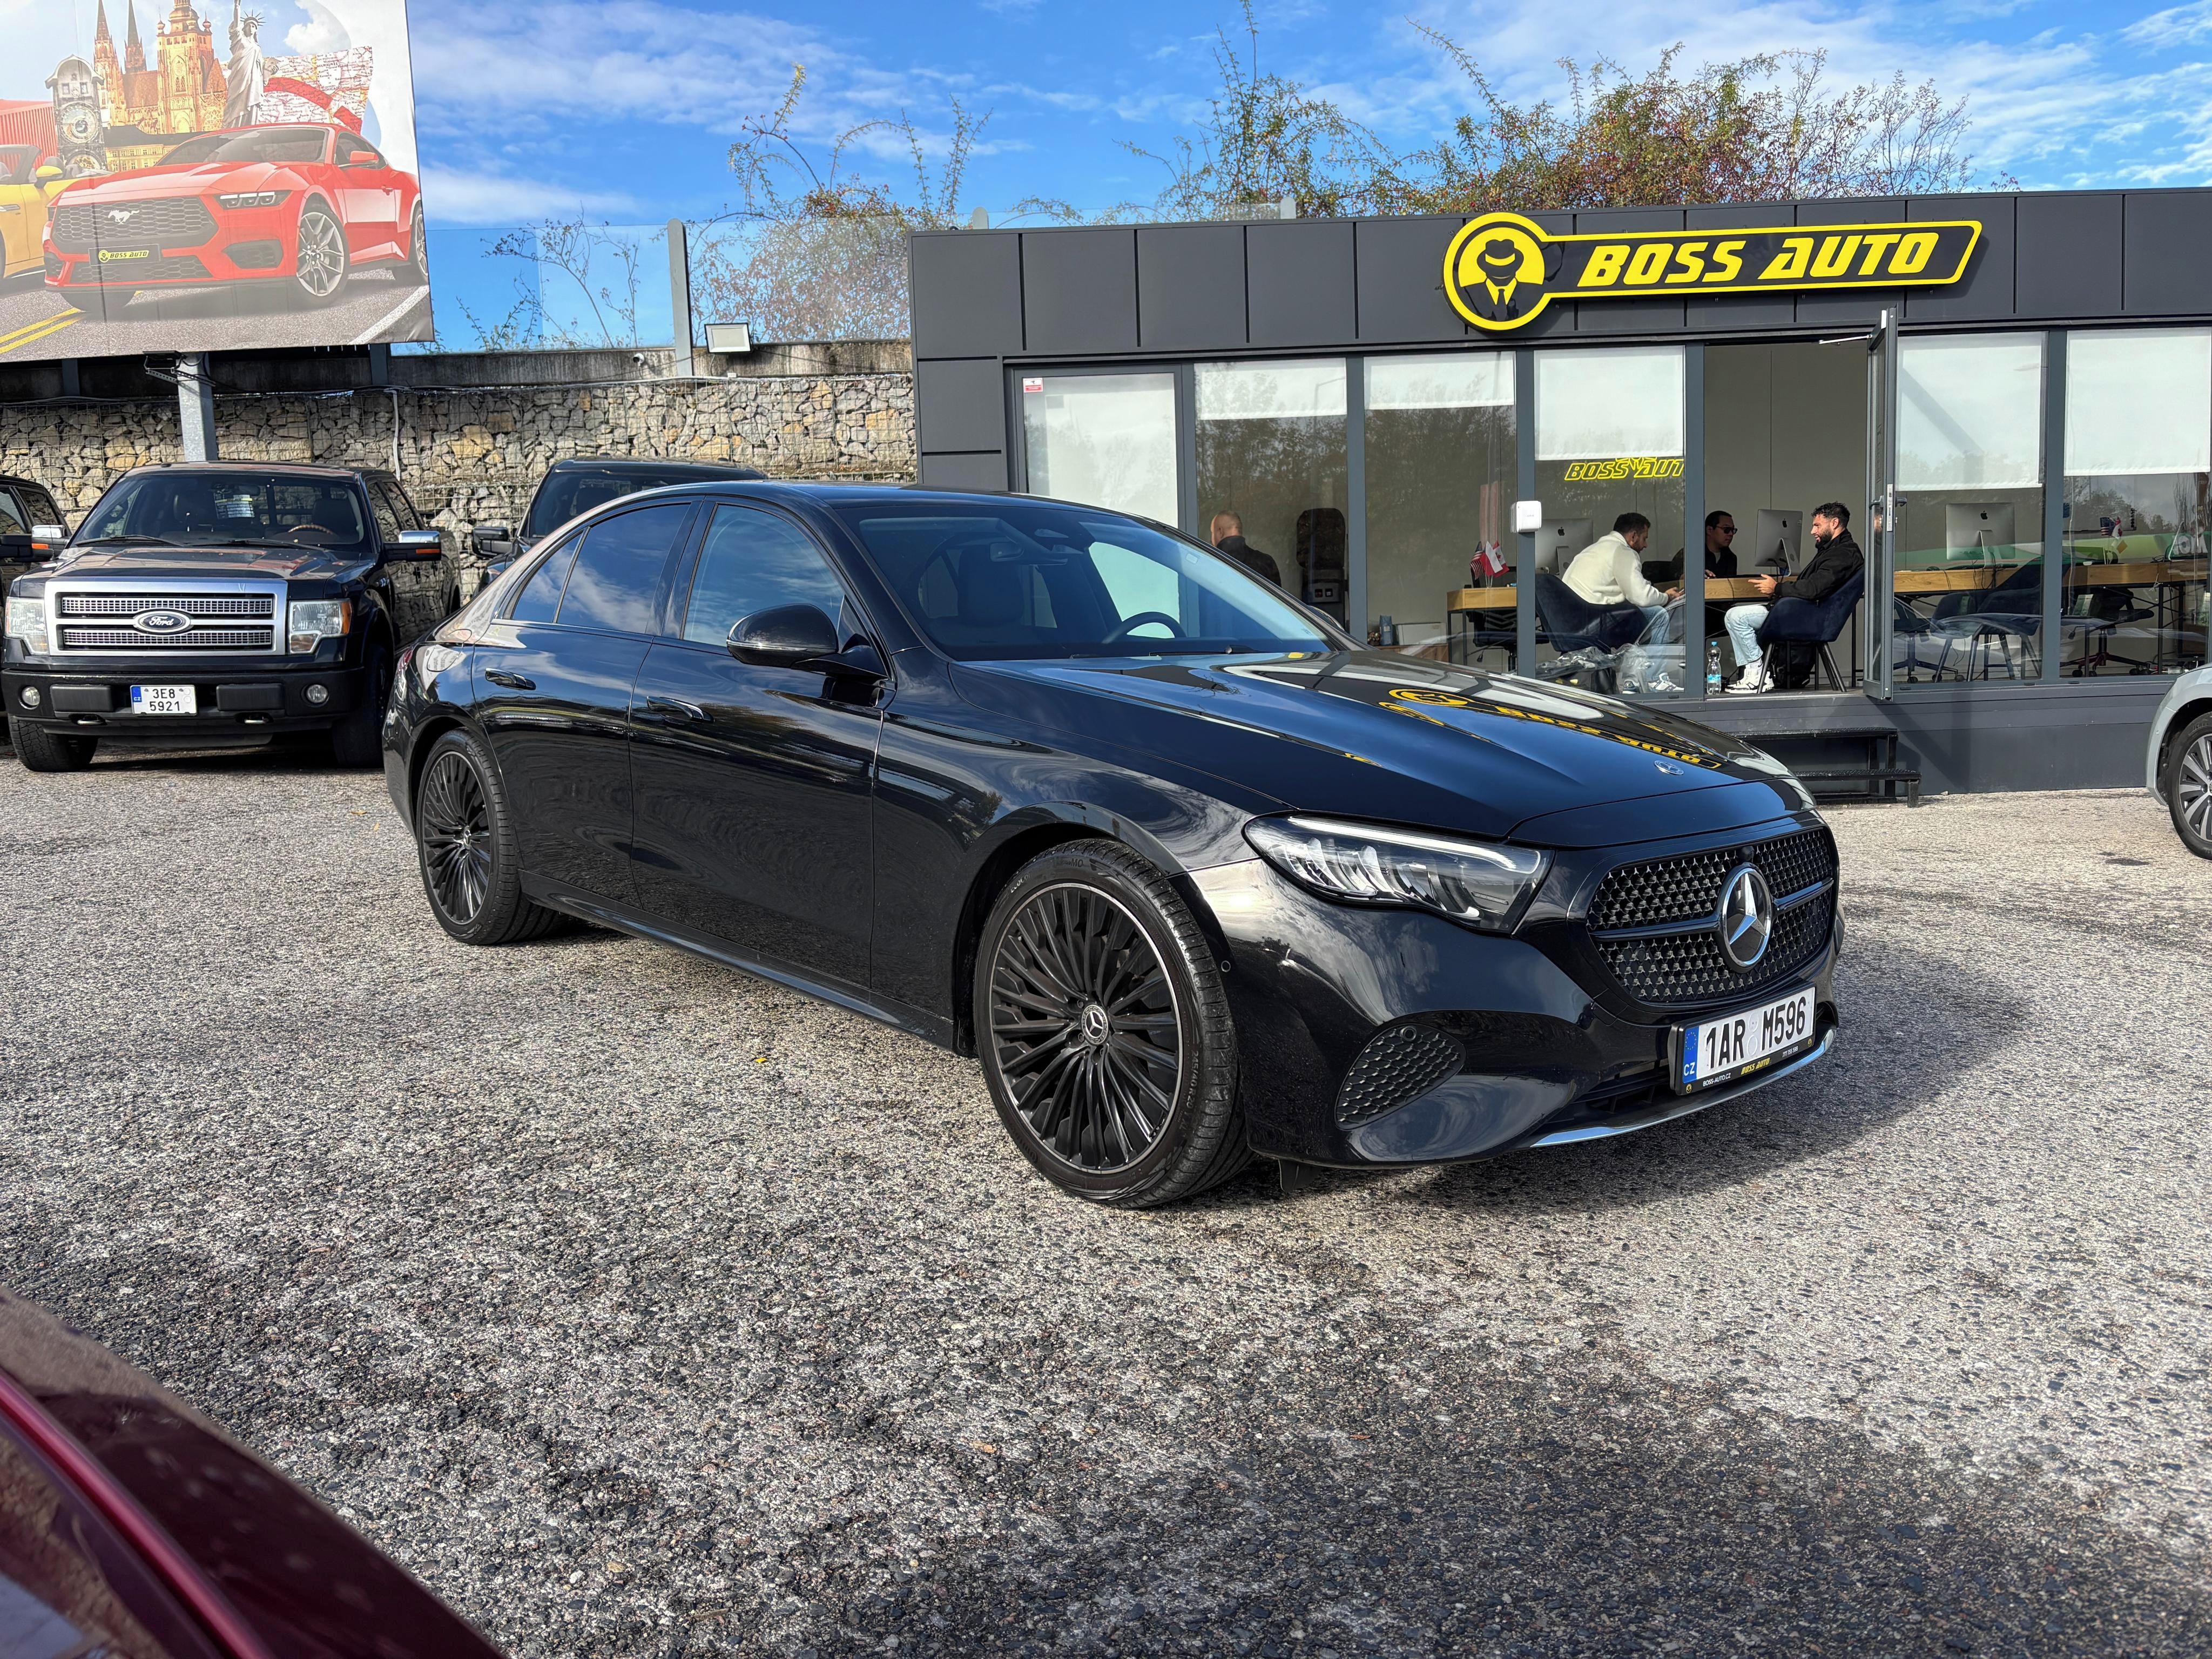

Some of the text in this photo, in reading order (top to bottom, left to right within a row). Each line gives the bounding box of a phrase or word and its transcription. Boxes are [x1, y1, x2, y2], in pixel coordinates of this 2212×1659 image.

[1577, 232, 1939, 287] BOSS AUTO
[1564, 458, 1684, 481] BOSS AUT
[149, 616, 174, 626] Ford
[152, 689, 176, 699] 3E8
[149, 701, 180, 711] 5921
[1706, 996, 1806, 1069] 1AR M596
[1684, 1062, 1696, 1076] CZ
[1741, 1063, 1755, 1075] BOSS
[1756, 1057, 1771, 1070] AUTO
